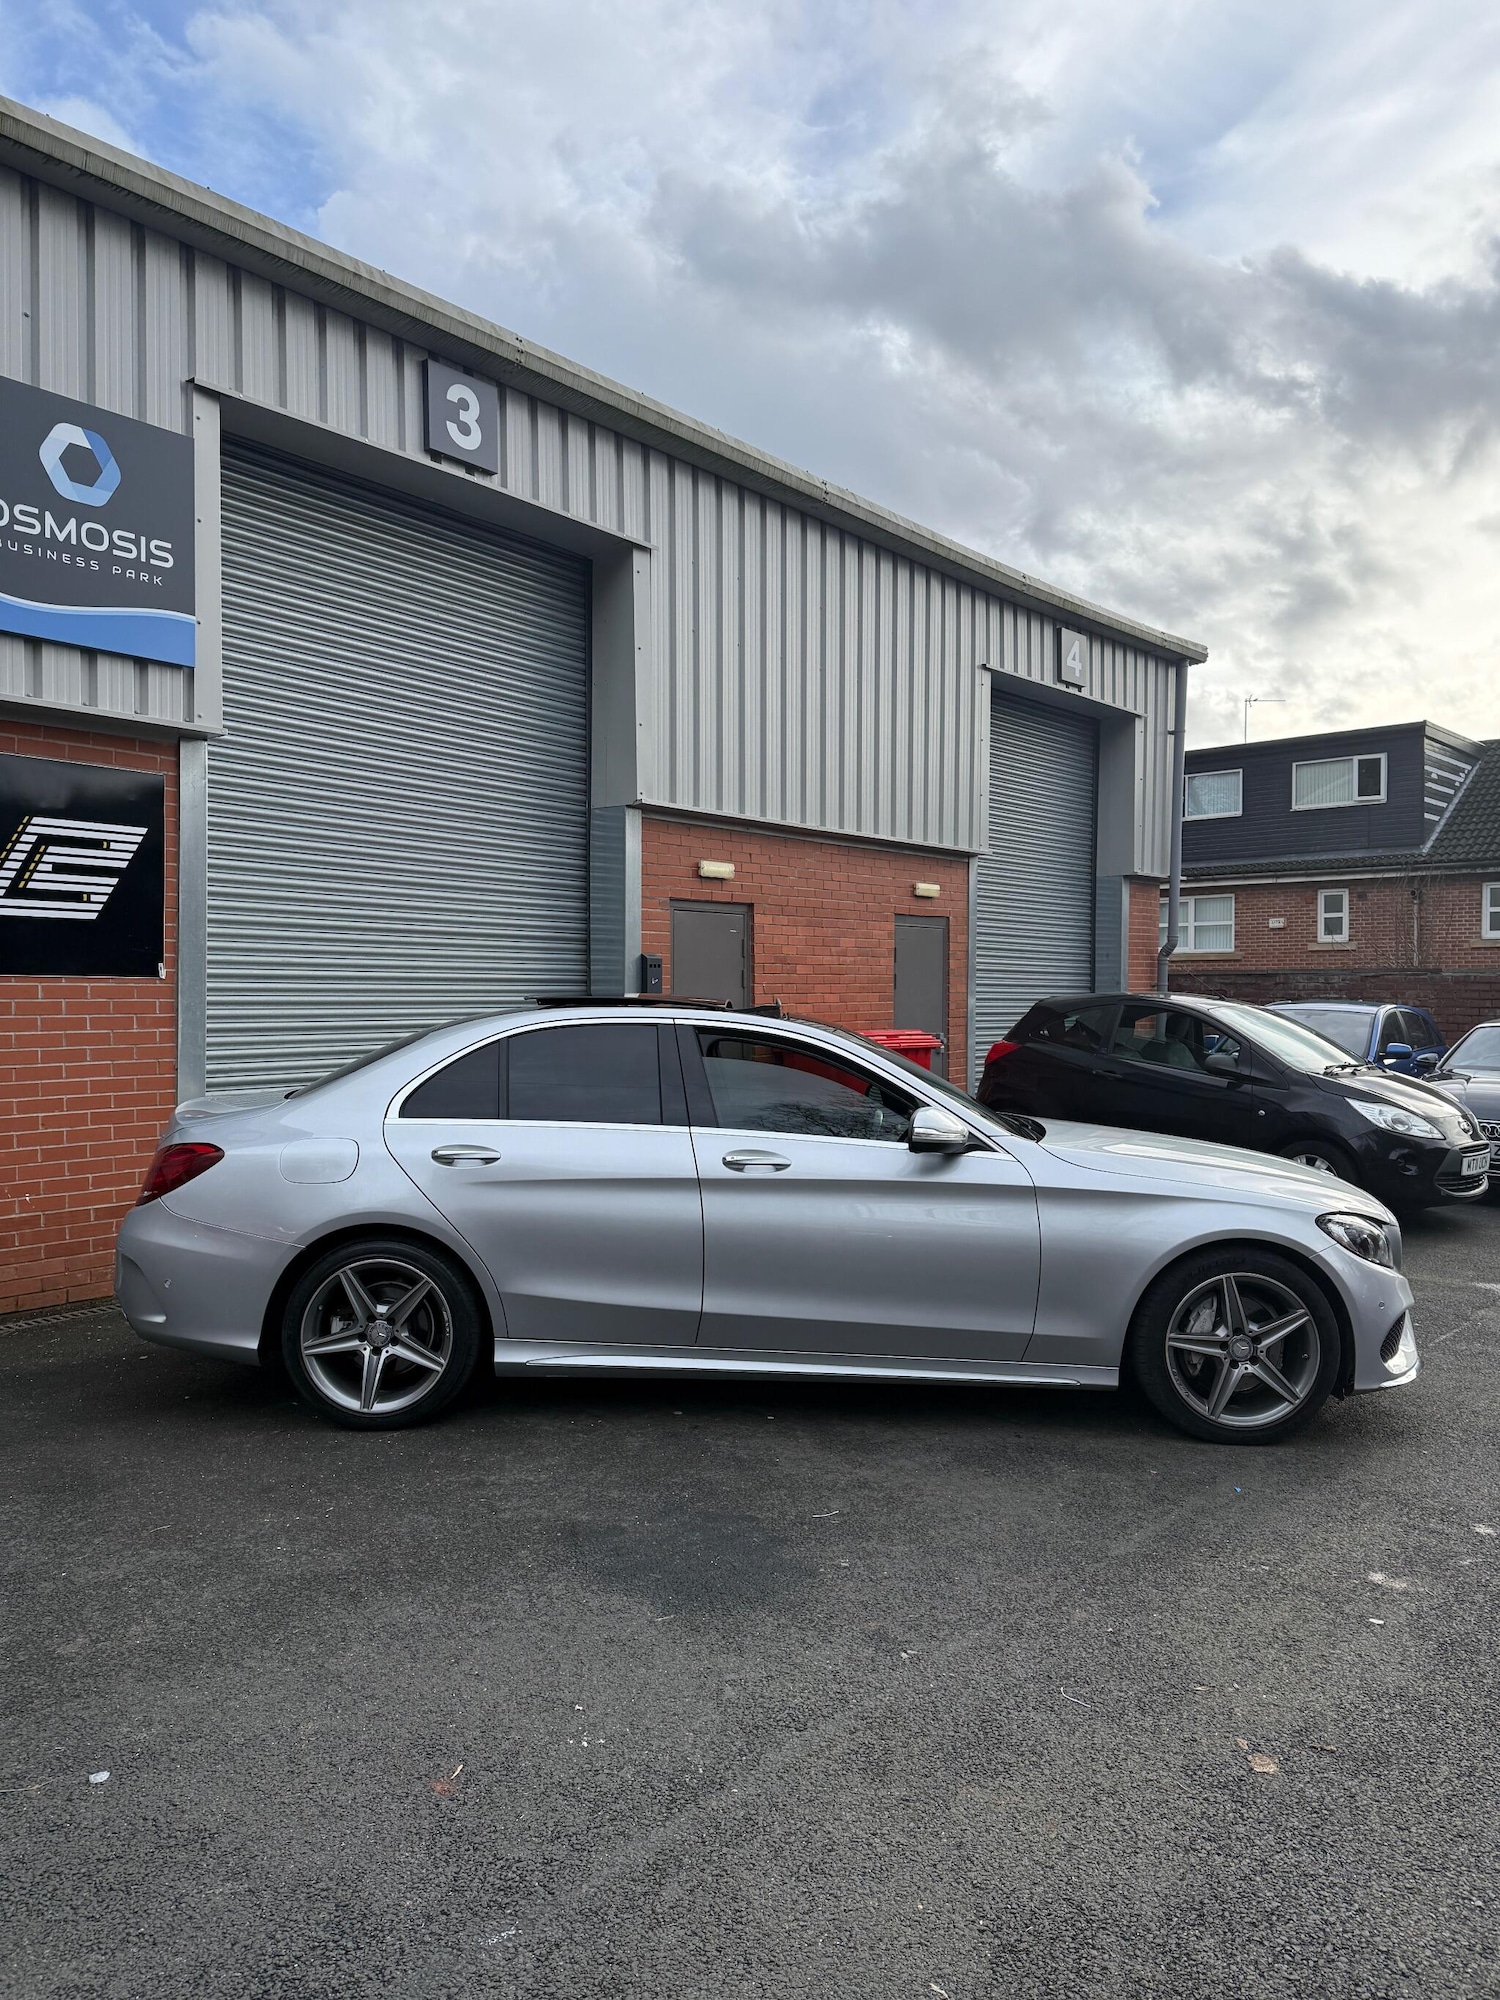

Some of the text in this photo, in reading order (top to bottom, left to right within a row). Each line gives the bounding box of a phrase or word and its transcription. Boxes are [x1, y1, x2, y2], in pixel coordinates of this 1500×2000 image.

[446, 383, 482, 451] 3
[0, 539, 163, 586] USINESS PARK
[1066, 640, 1082, 677] 4
